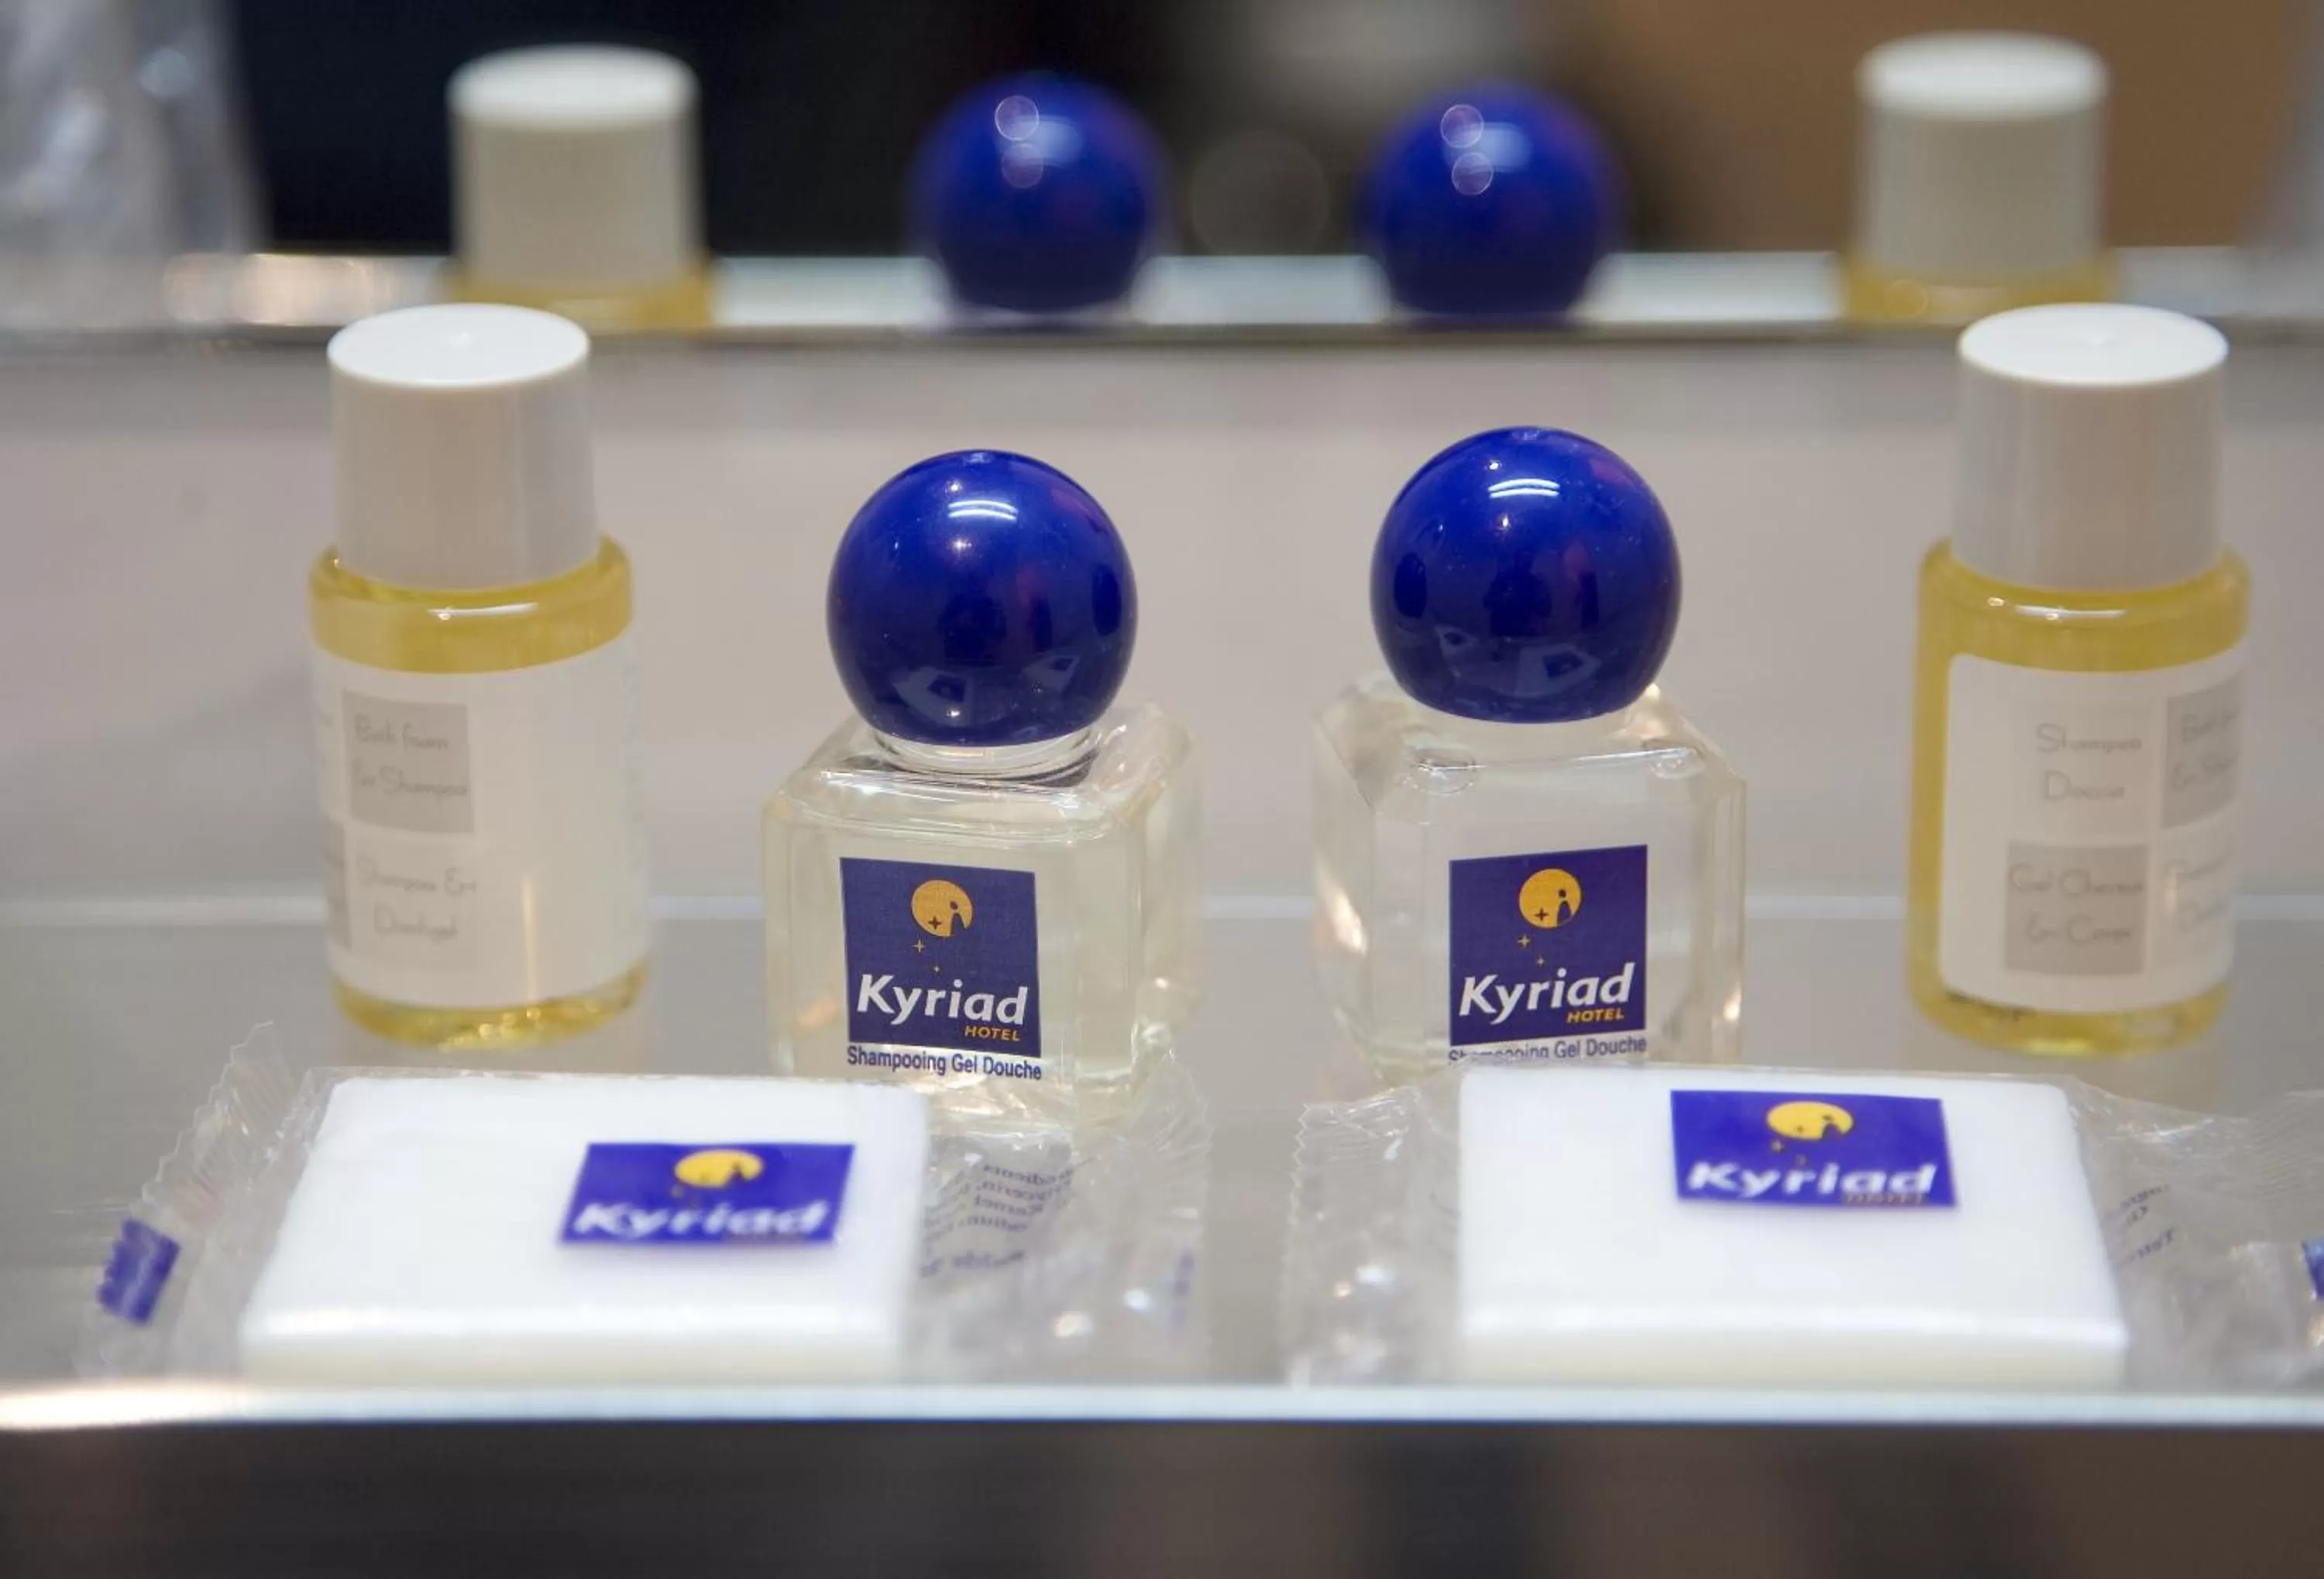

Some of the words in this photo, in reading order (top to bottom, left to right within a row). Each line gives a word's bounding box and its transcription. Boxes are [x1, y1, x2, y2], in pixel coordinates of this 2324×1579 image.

[857, 974, 1028, 1025] Kyriad
[1459, 962, 1635, 1025] Kyriad
[964, 1026, 1020, 1041] HOTEL
[1566, 1008, 1624, 1023] HOTEL
[847, 1046, 946, 1075] Shampooing
[951, 1053, 978, 1073] Gel
[983, 1057, 1041, 1080] Douche
[1554, 1040, 1580, 1059] Gel
[1586, 1036, 1647, 1056] Douche
[1686, 1161, 1937, 1199] Kyriad
[572, 1199, 828, 1237] Kyriad
